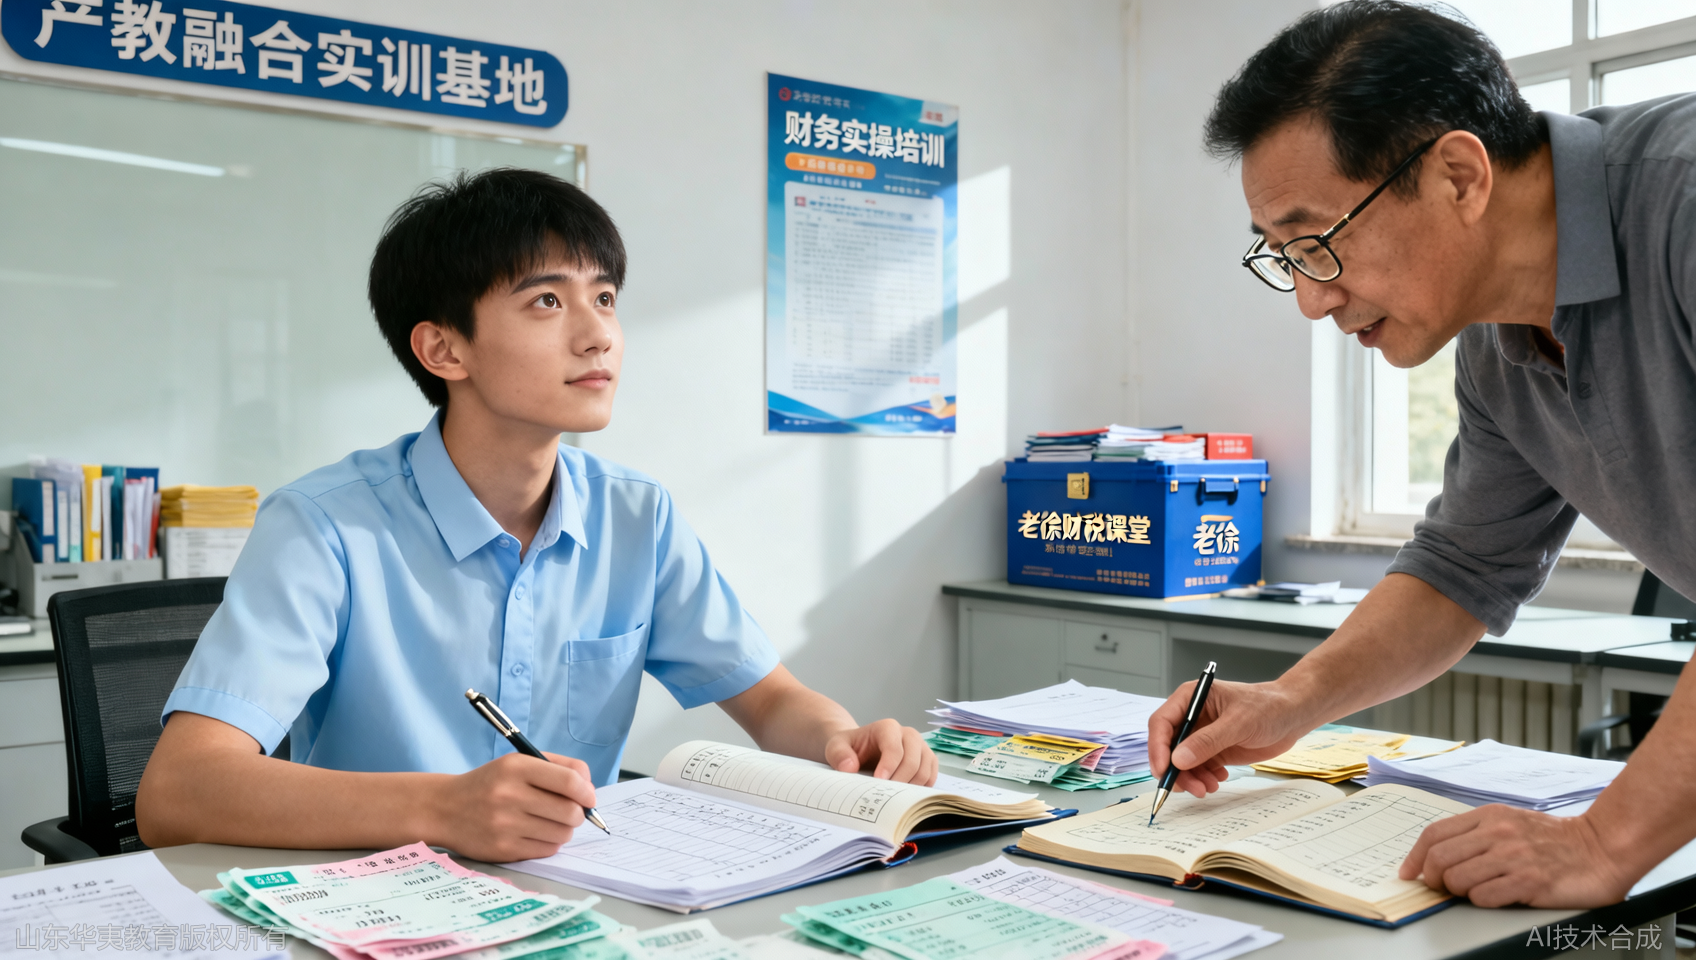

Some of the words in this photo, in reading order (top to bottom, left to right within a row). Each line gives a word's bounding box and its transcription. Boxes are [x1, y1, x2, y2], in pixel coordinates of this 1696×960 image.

[34, 0, 547, 116] 产教融合实训基地
[784, 110, 945, 168] 财务实操培训
[1018, 509, 1151, 545] 老徐财税课堂
[1192, 521, 1240, 555] 老徐
